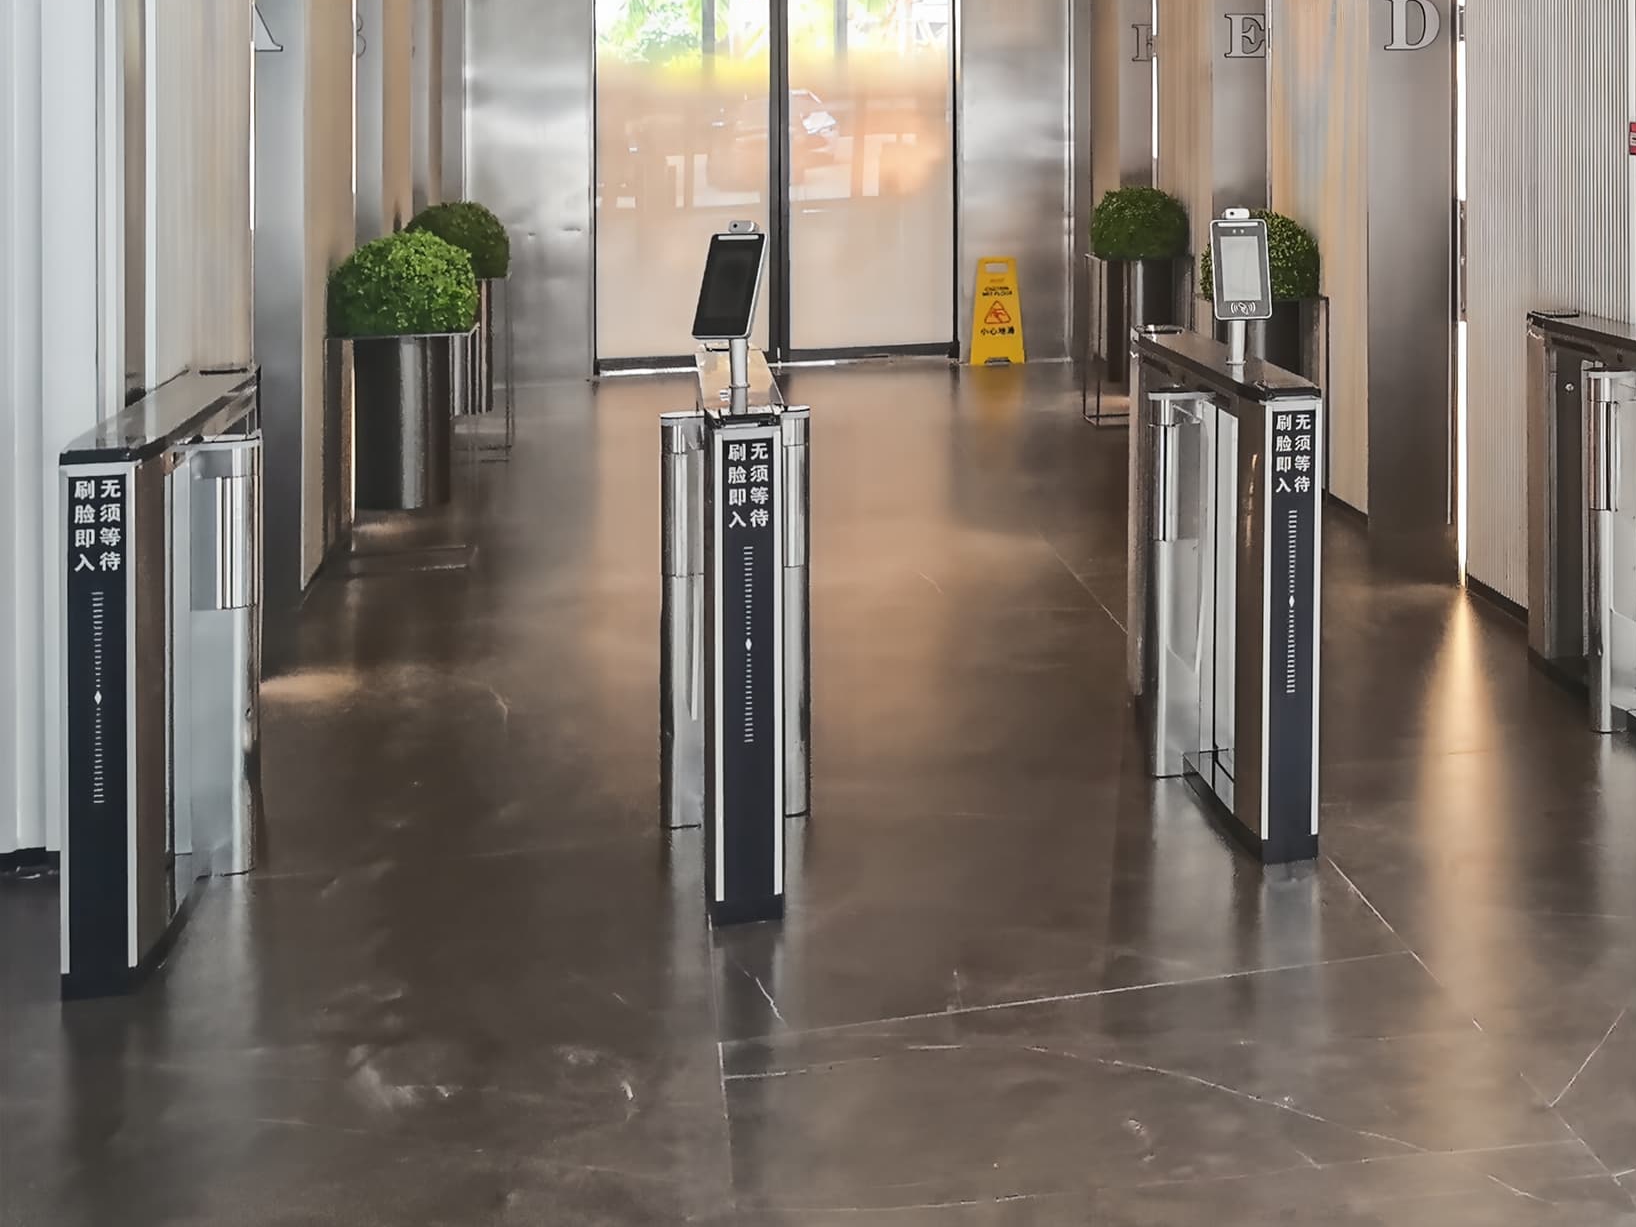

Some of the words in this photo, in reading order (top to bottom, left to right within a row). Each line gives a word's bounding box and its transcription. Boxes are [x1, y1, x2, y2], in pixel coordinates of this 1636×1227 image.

[1224, 13, 1265, 58] E
[980, 326, 1015, 336] 小心地滑
[728, 444, 746, 528] 刷脸即入
[750, 443, 769, 527] 无须等待
[1276, 414, 1292, 493] 刷脸即入
[1294, 414, 1311, 492] 无须等待
[74, 479, 95, 572] 刷脸即入
[99, 479, 121, 572] 无须等待
